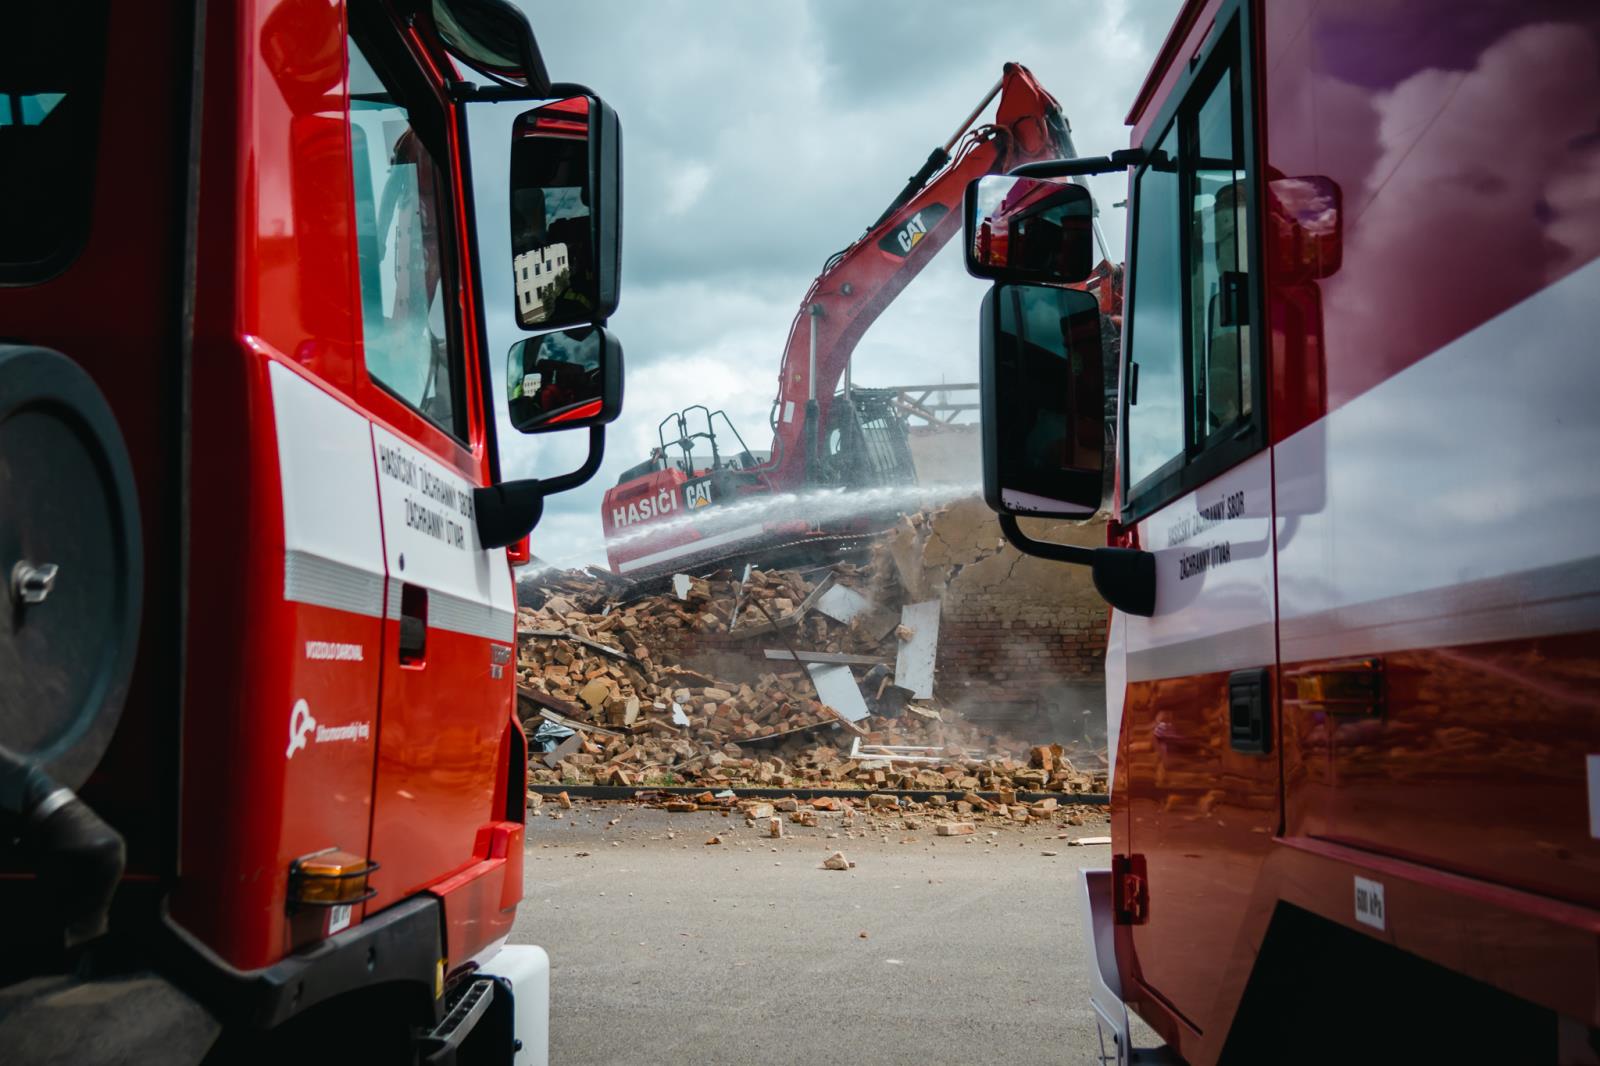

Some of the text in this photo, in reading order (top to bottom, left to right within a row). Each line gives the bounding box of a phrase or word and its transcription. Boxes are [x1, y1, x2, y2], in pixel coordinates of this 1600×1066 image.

[897, 212, 927, 252] CAT
[419, 463, 457, 511] ZÁCHRANNÝ
[458, 491, 472, 519] SBOR
[613, 488, 677, 528] HASIČI
[686, 480, 712, 509] CAT
[1227, 490, 1245, 520] SBOR
[405, 494, 444, 541] ZÁCHRANNÝ
[1180, 540, 1231, 580] ZÁCHRANNÝ ÚTVAR
